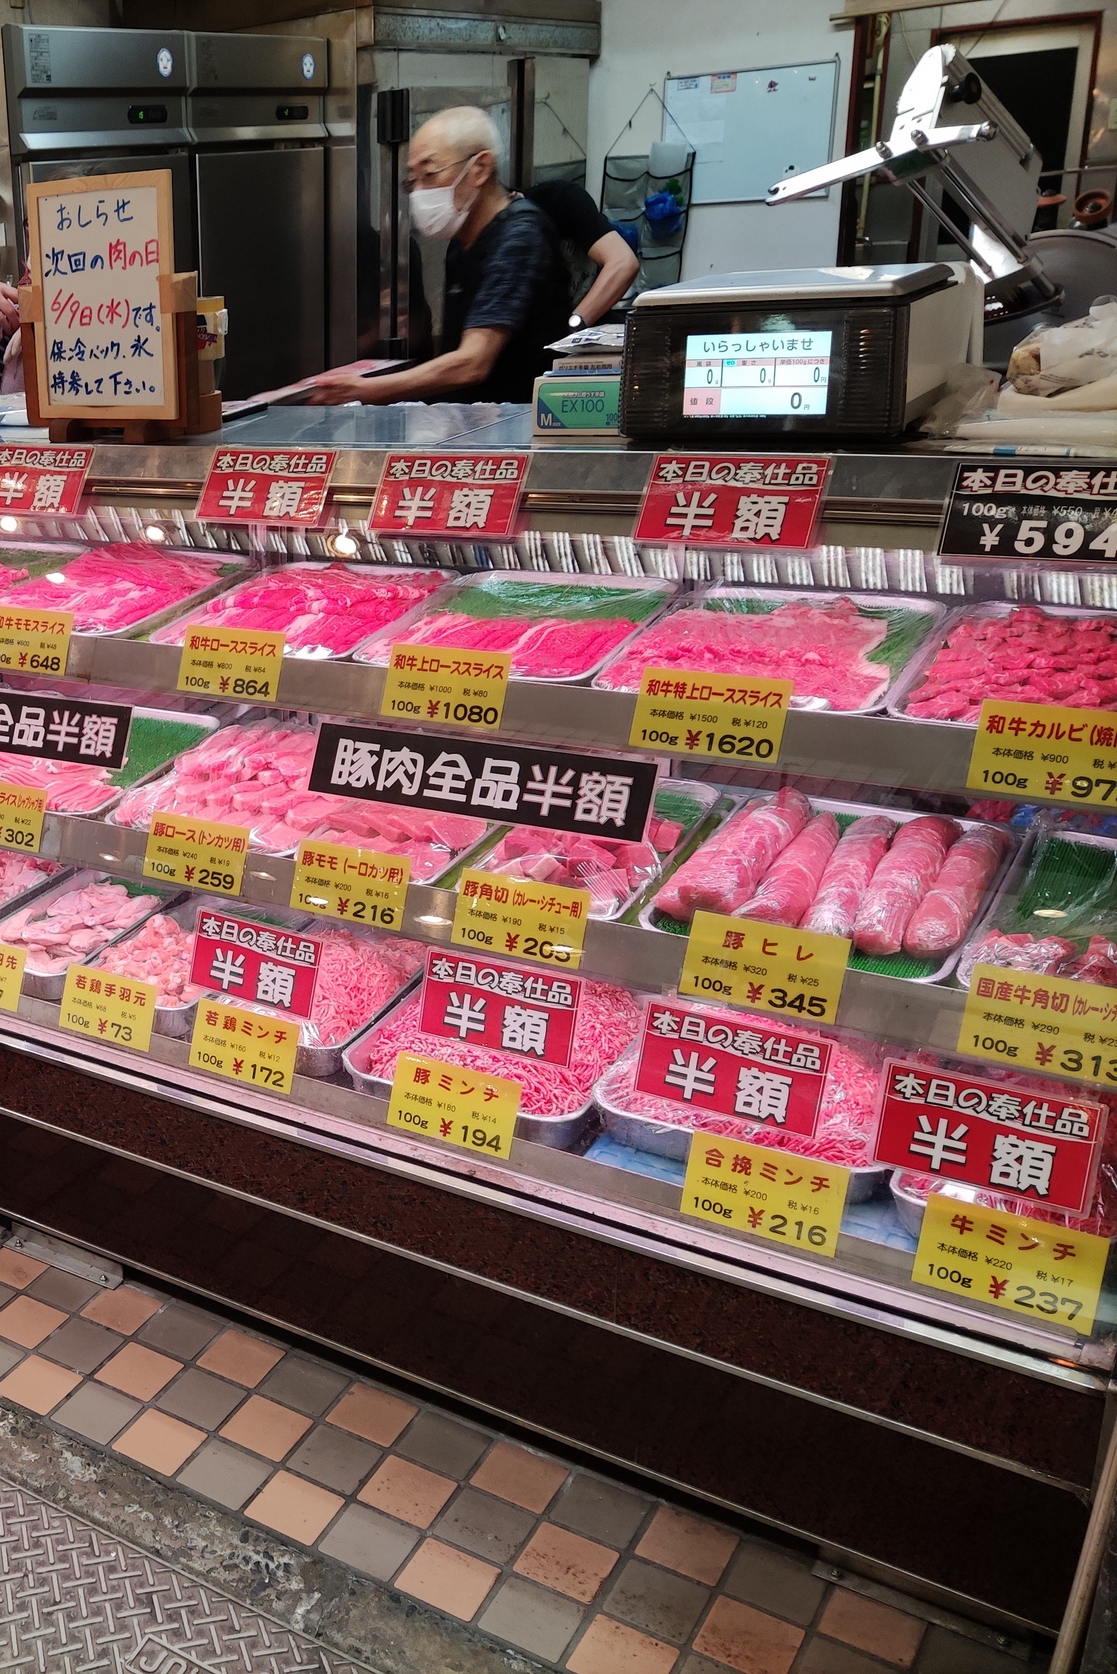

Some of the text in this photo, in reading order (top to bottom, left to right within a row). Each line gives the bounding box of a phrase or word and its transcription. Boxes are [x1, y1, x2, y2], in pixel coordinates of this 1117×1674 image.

[57, 199, 134, 232] おしらせ
[45, 239, 159, 278] 次回の肉の日
[703, 338, 813, 353] いらっしゃいませ
[50, 371, 156, 397] 持参して下さい。
[707, 369, 713, 384] 0
[760, 368, 766, 383] 0
[813, 367, 820, 383] 0
[561, 399, 604, 413] EX100
[690, 392, 802, 409] 値段 0
[540, 413, 552, 426] M
[217, 452, 327, 473] 本日の奉仕品
[389, 458, 519, 481] 本日の奉仕品
[658, 460, 819, 487] 本日の奉仕品
[221, 478, 306, 519] 半額
[394, 486, 494, 529] 半額
[962, 502, 1007, 518] 100g
[665, 492, 790, 542] 半額
[980, 520, 1117, 558] ¥594
[189, 635, 276, 657] 和牛ローススライス
[19, 652, 60, 671] ¥648
[394, 653, 504, 680] 和牛上ローススライス
[185, 676, 270, 697] 100g ¥864
[398, 681, 488, 698] 本体価格 ¥1000 ¥80
[646, 679, 783, 708] 和牛特上ローススライス
[390, 699, 498, 725] 100g ¥1080
[650, 708, 768, 729] 本体価格 ¥1500 ¥120
[641, 729, 774, 758] 100g ¥1620
[986, 715, 1117, 748] 和牛カルビ(焼
[992, 747, 1069, 764] 本体価格 ¥900
[330, 738, 633, 827] 豚肉全品半額
[983, 770, 1117, 801] 100g ¥97
[151, 862, 234, 890] 100g ¥259
[337, 897, 395, 925] ¥216
[202, 916, 316, 963] 本日の奉仕品
[461, 927, 493, 945] 100g
[723, 930, 814, 961] 豚ヒレ
[210, 948, 296, 1008] 半額
[701, 955, 767, 976] 本体価格 ¥320
[75, 974, 147, 1007] 若鶏手羽元
[432, 958, 573, 1006] 本日の奉仕品
[693, 975, 827, 1017] 100g ¥345
[66, 1013, 132, 1042] 100g ¥73
[206, 1010, 288, 1044] 若鶏ミンチ
[444, 992, 549, 1056] 半額
[983, 1012, 1059, 1035] 本体価格 ¥290
[652, 1011, 822, 1071] 本日の奉仕品
[973, 1035, 1019, 1057] 100g
[197, 1051, 284, 1088] 100g ¥172
[413, 1067, 499, 1102] 豚ミンチ
[665, 1048, 793, 1125] 半額
[894, 1072, 1090, 1139] 本日の奉仕品
[398, 1110, 502, 1152] 100g ¥194
[909, 1114, 1056, 1197] 半額
[701, 1176, 767, 1201] 本体価格 ¥200
[694, 1196, 827, 1246] 100g ¥216
[951, 1214, 1077, 1261] 牛ミンチ
[937, 1242, 1012, 1271] 本体価格 ¥220
[928, 1263, 1084, 1321] 100g ¥237
